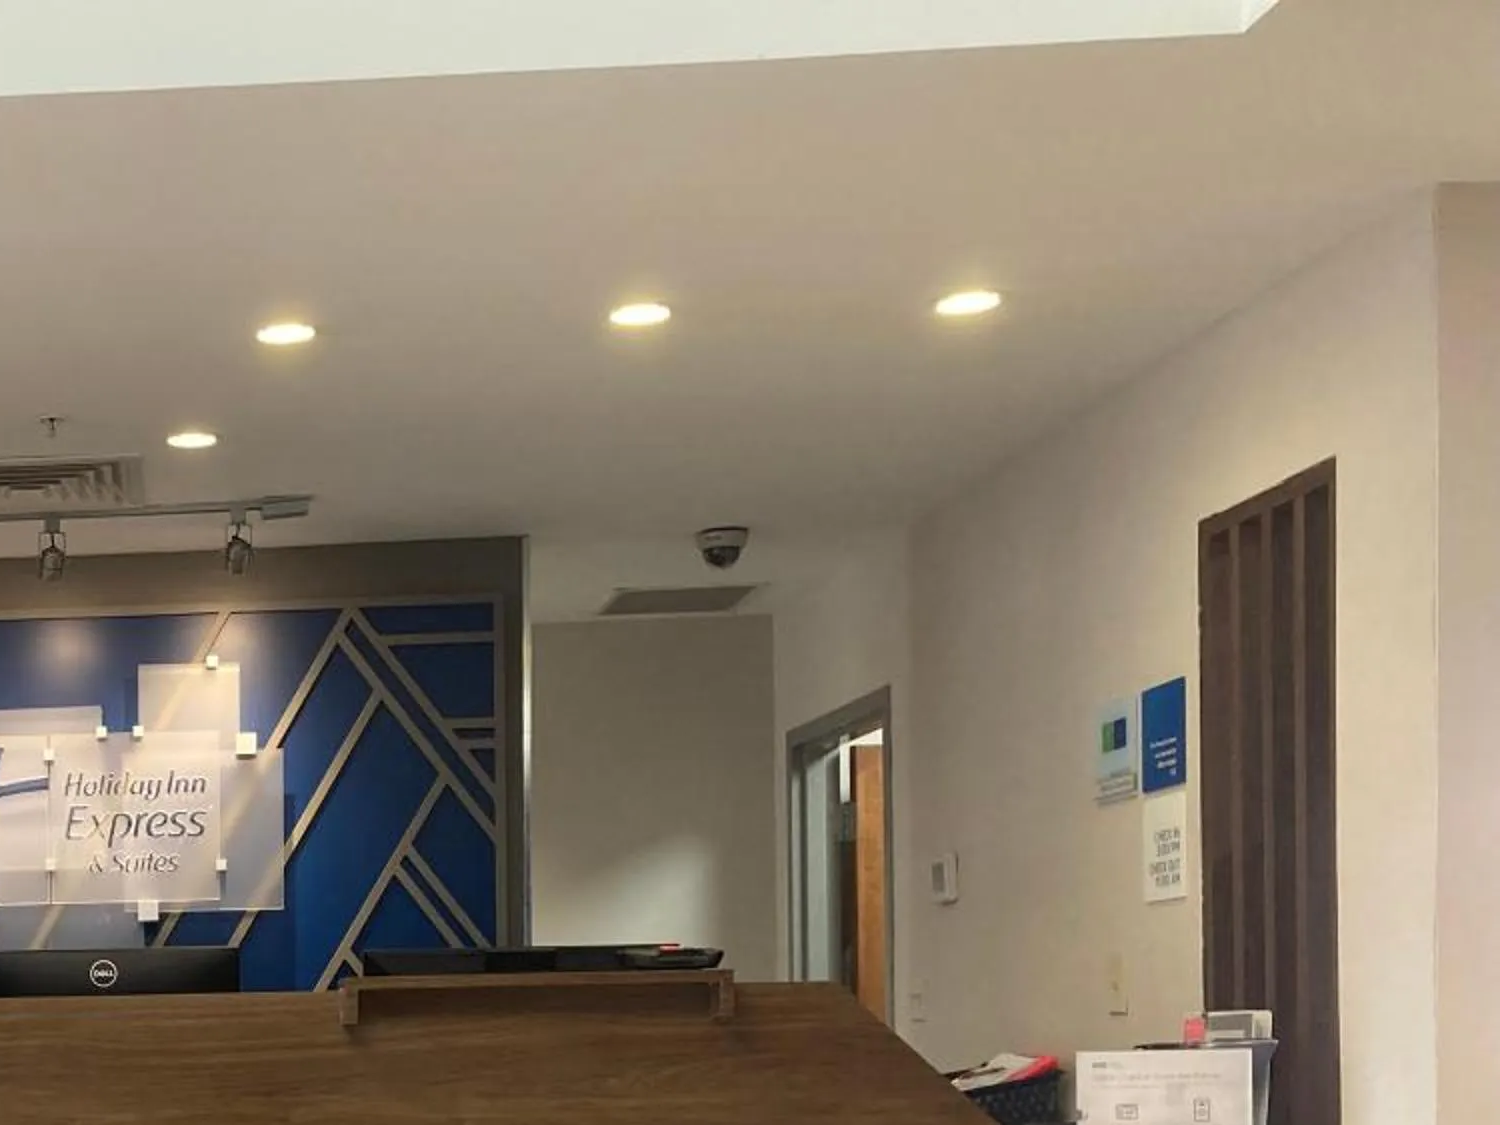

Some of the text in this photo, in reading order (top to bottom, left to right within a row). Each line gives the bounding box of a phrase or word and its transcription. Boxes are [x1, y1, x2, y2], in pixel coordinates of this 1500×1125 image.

[64, 770, 206, 802] Holiday Inn
[64, 804, 206, 848] Express
[88, 849, 181, 874] & Suites
[93, 968, 115, 979] DELL
